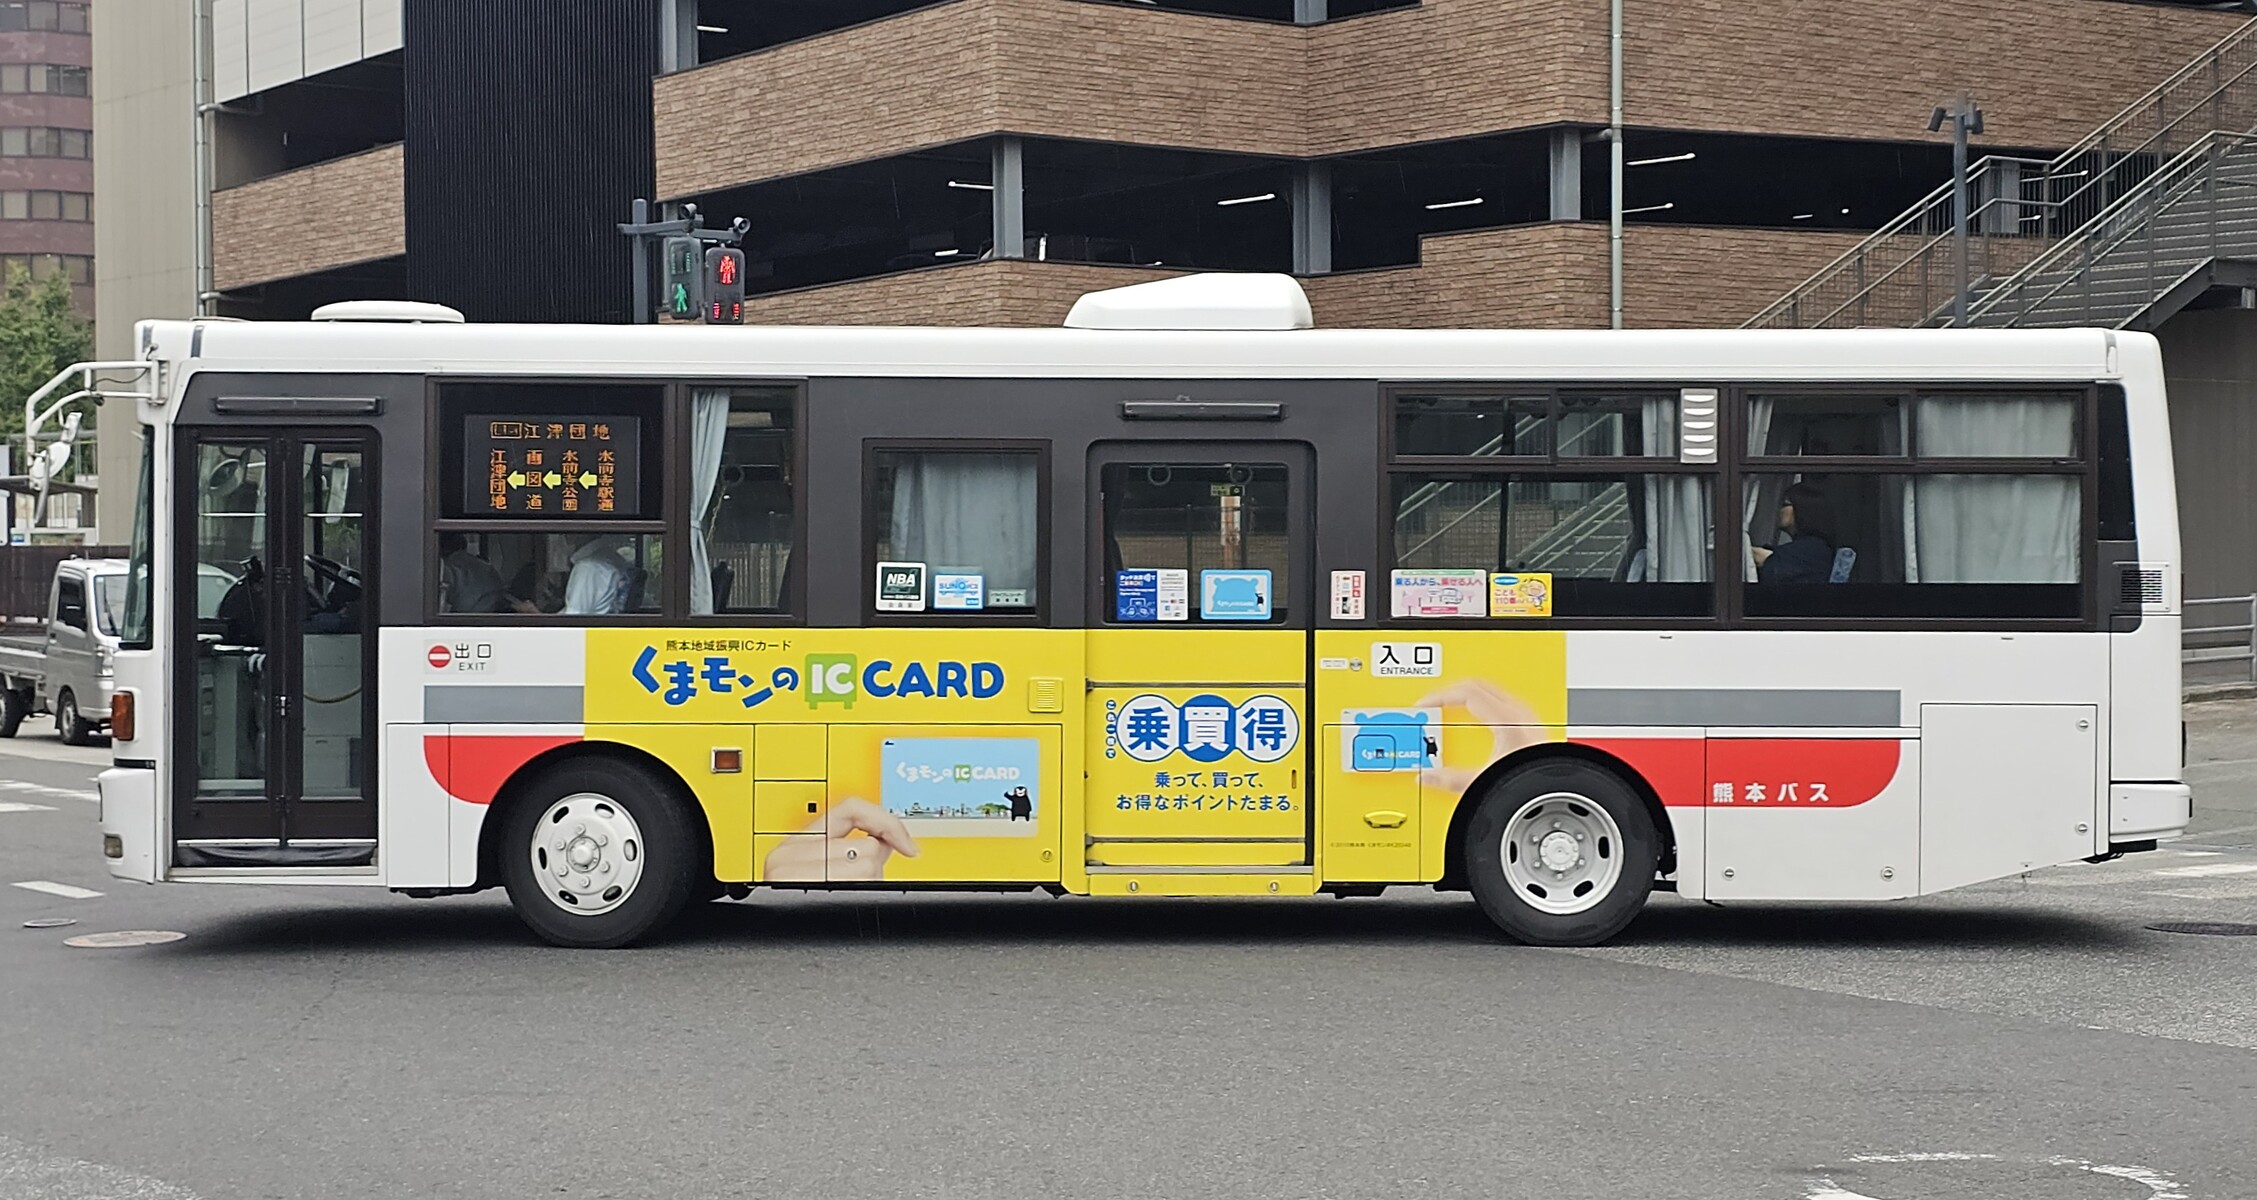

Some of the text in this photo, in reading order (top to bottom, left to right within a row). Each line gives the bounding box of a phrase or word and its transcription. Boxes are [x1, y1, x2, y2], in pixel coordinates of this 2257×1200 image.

[886, 573, 915, 587] NBA
[455, 643, 491, 659] 出口
[666, 640, 792, 651] 熊本地域振興ICカード
[1380, 645, 1433, 665] 入口
[459, 662, 486, 671] EXIT
[1380, 667, 1434, 675] ENTRANCE
[632, 645, 1005, 708] くまモンの IC CARD
[972, 766, 1020, 780] CARD
[1155, 772, 1264, 788] 乗って、買って、
[1713, 783, 1829, 803] 熊本バス
[1116, 794, 1299, 811] お得なポイントたまる。
